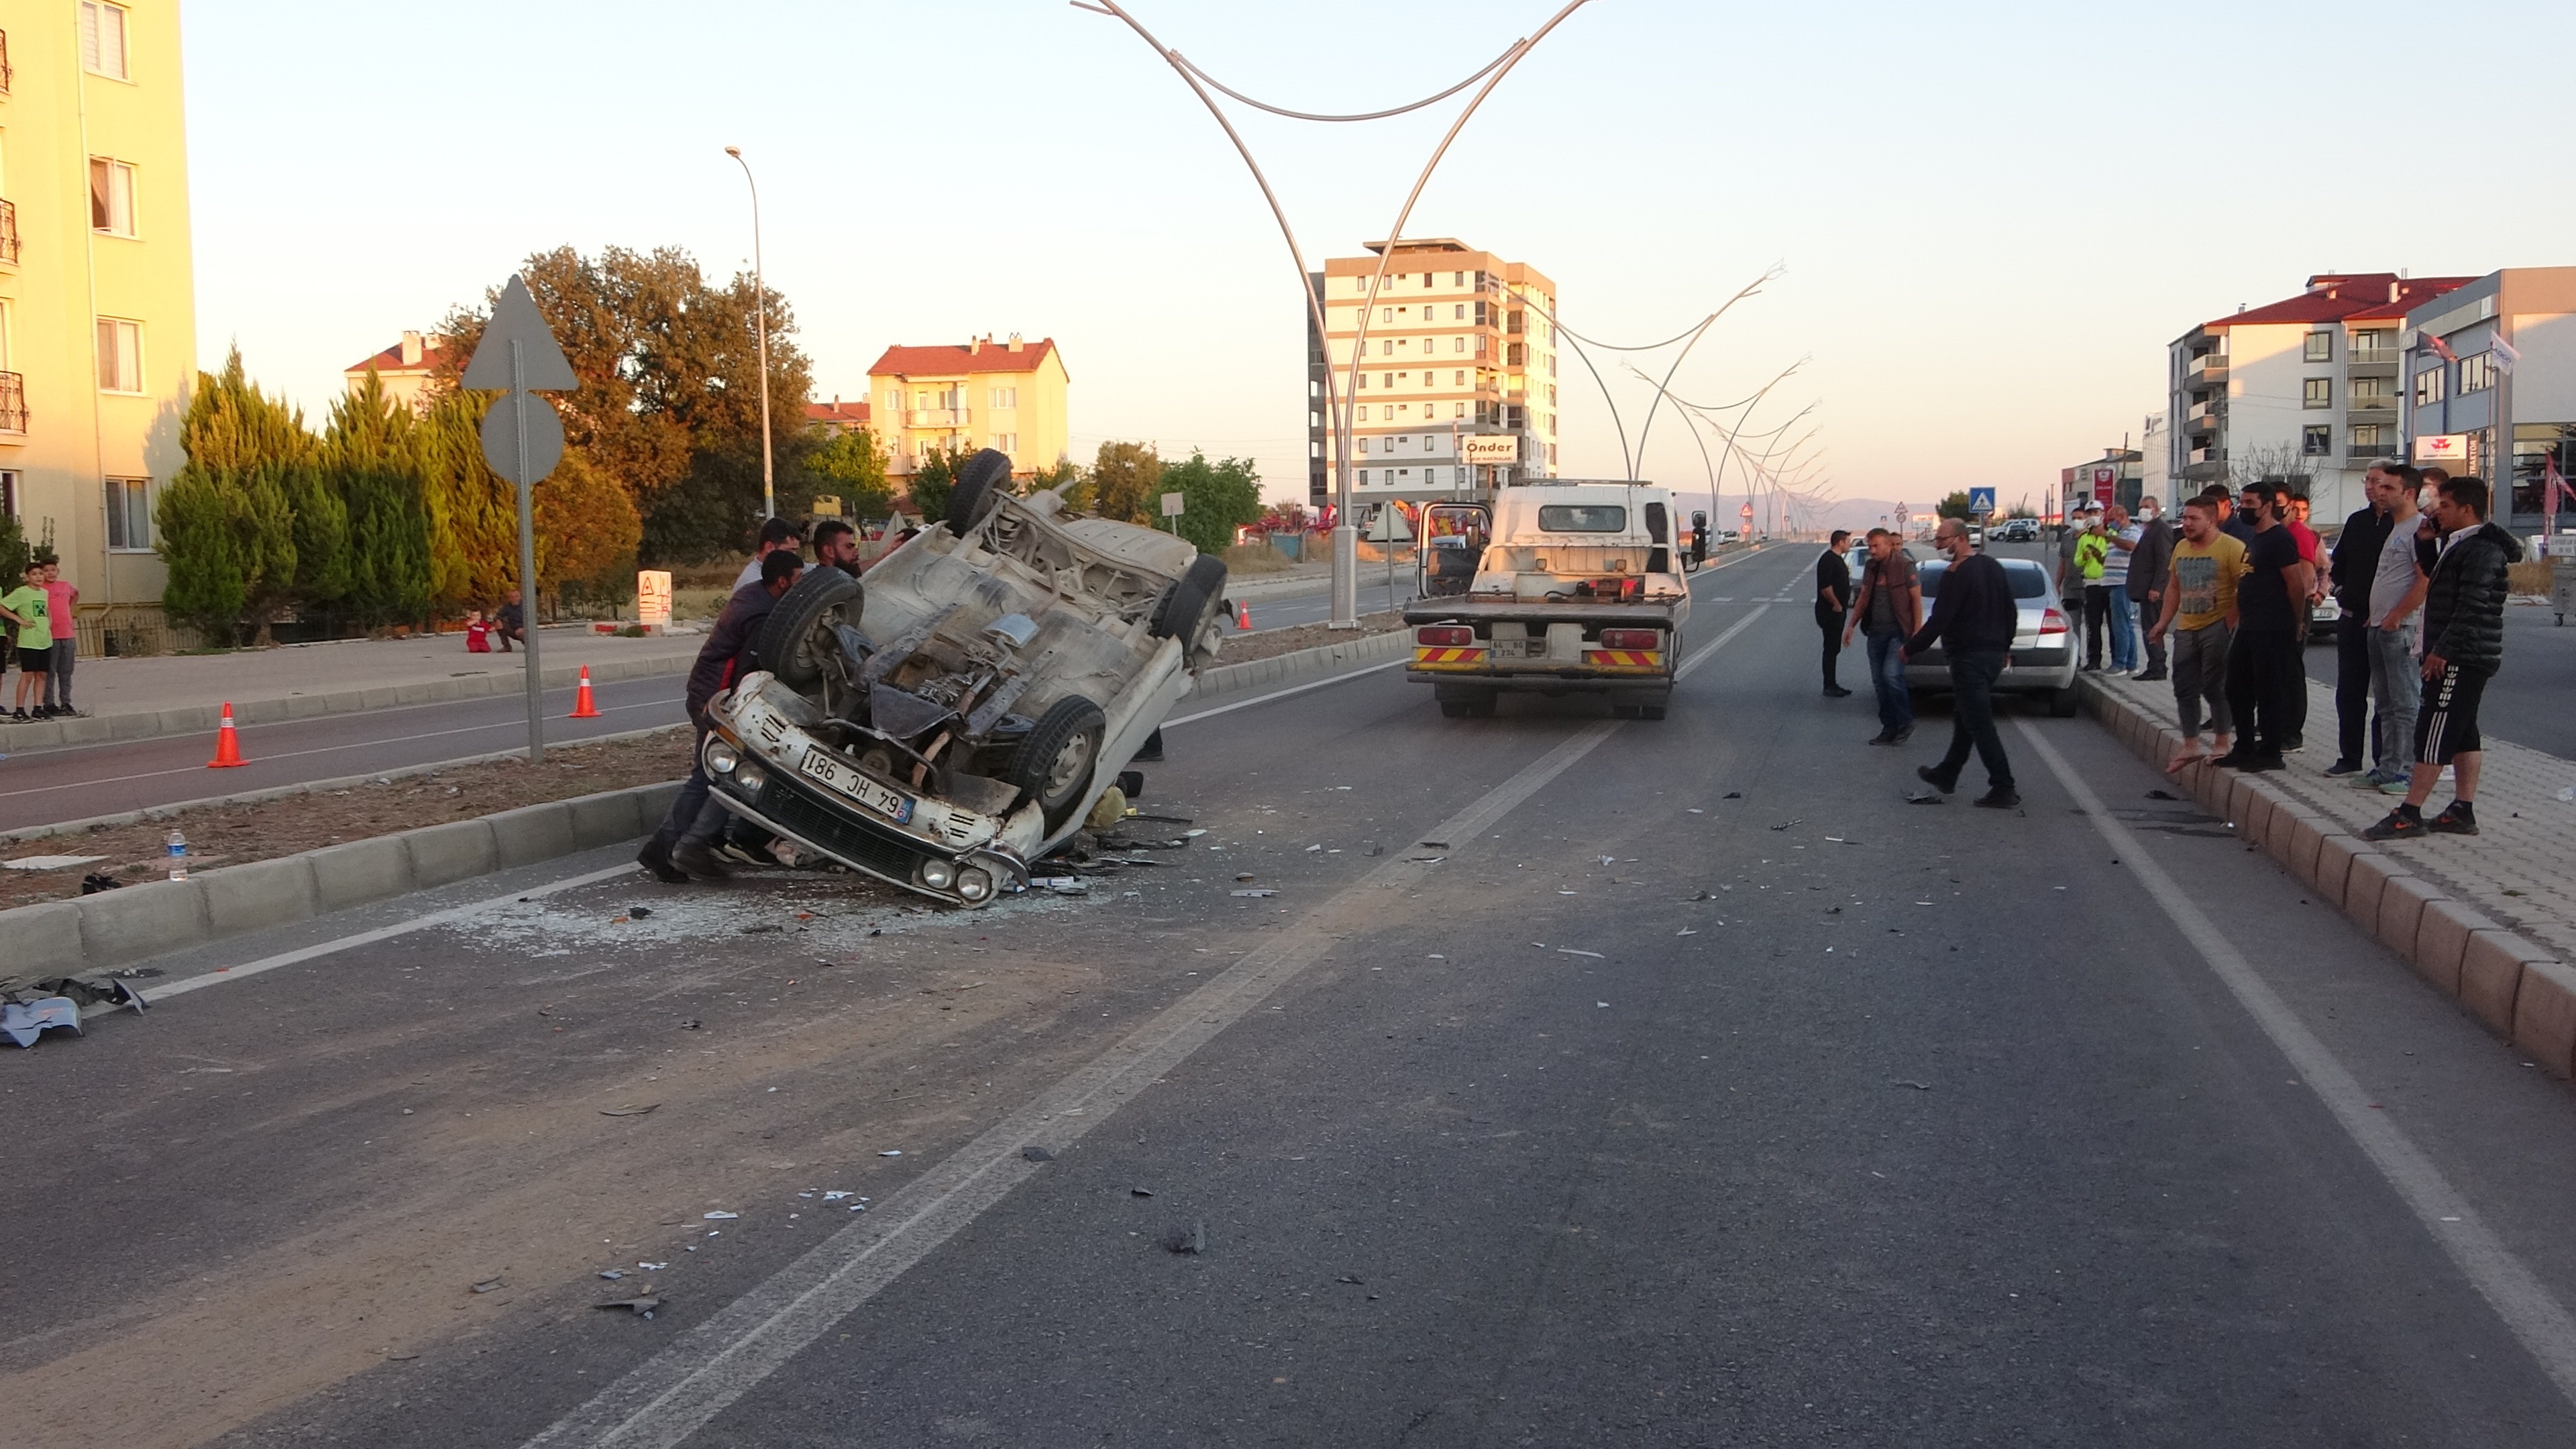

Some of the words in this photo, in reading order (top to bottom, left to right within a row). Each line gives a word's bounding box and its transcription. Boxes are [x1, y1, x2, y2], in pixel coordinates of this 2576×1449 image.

[1467, 440, 1513, 451] Önder
[806, 753, 837, 780] 981
[847, 774, 871, 798] HC
[877, 790, 900, 813] 64
